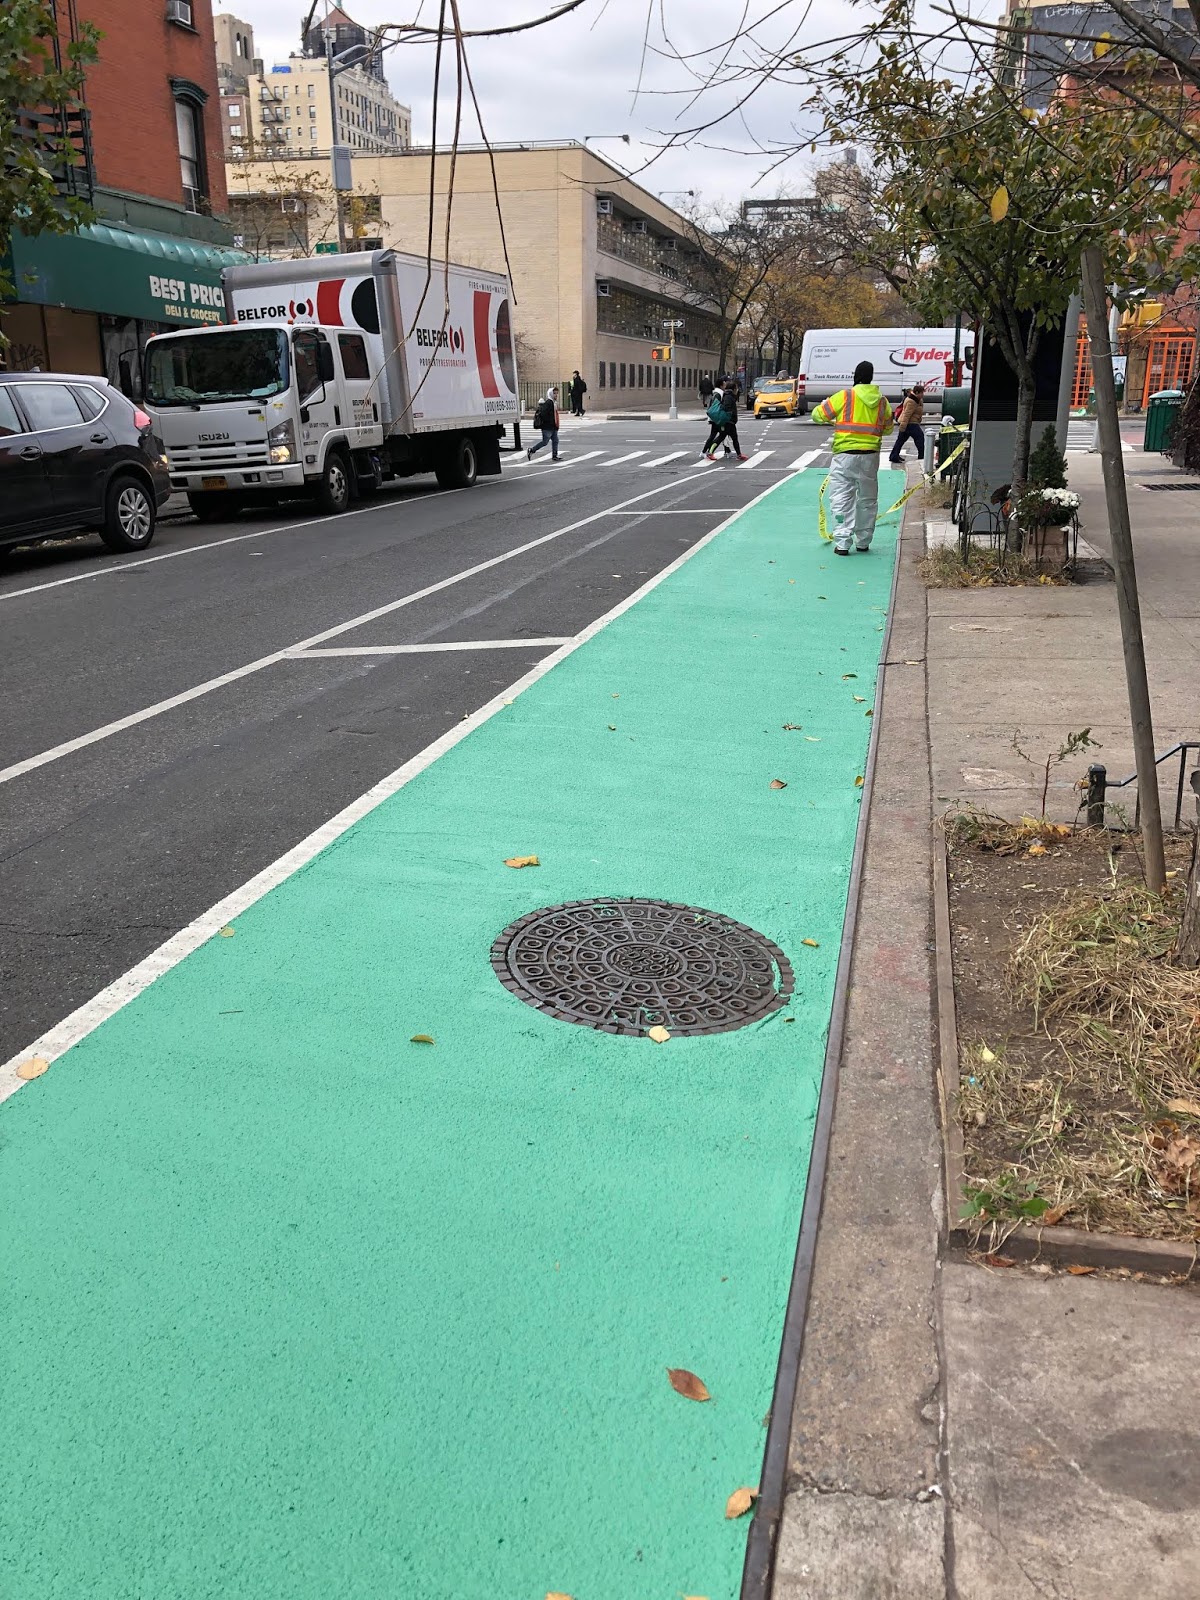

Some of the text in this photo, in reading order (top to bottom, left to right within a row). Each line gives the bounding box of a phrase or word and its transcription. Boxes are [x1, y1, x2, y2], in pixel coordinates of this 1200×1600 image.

[149, 275, 186, 302] BEST
[165, 304, 220, 322] DELI & GROCERY
[238, 305, 286, 321] BELFOR
[416, 328, 449, 348] BELFOR
[904, 347, 952, 363] Ryder
[198, 432, 230, 442] ISUZU
